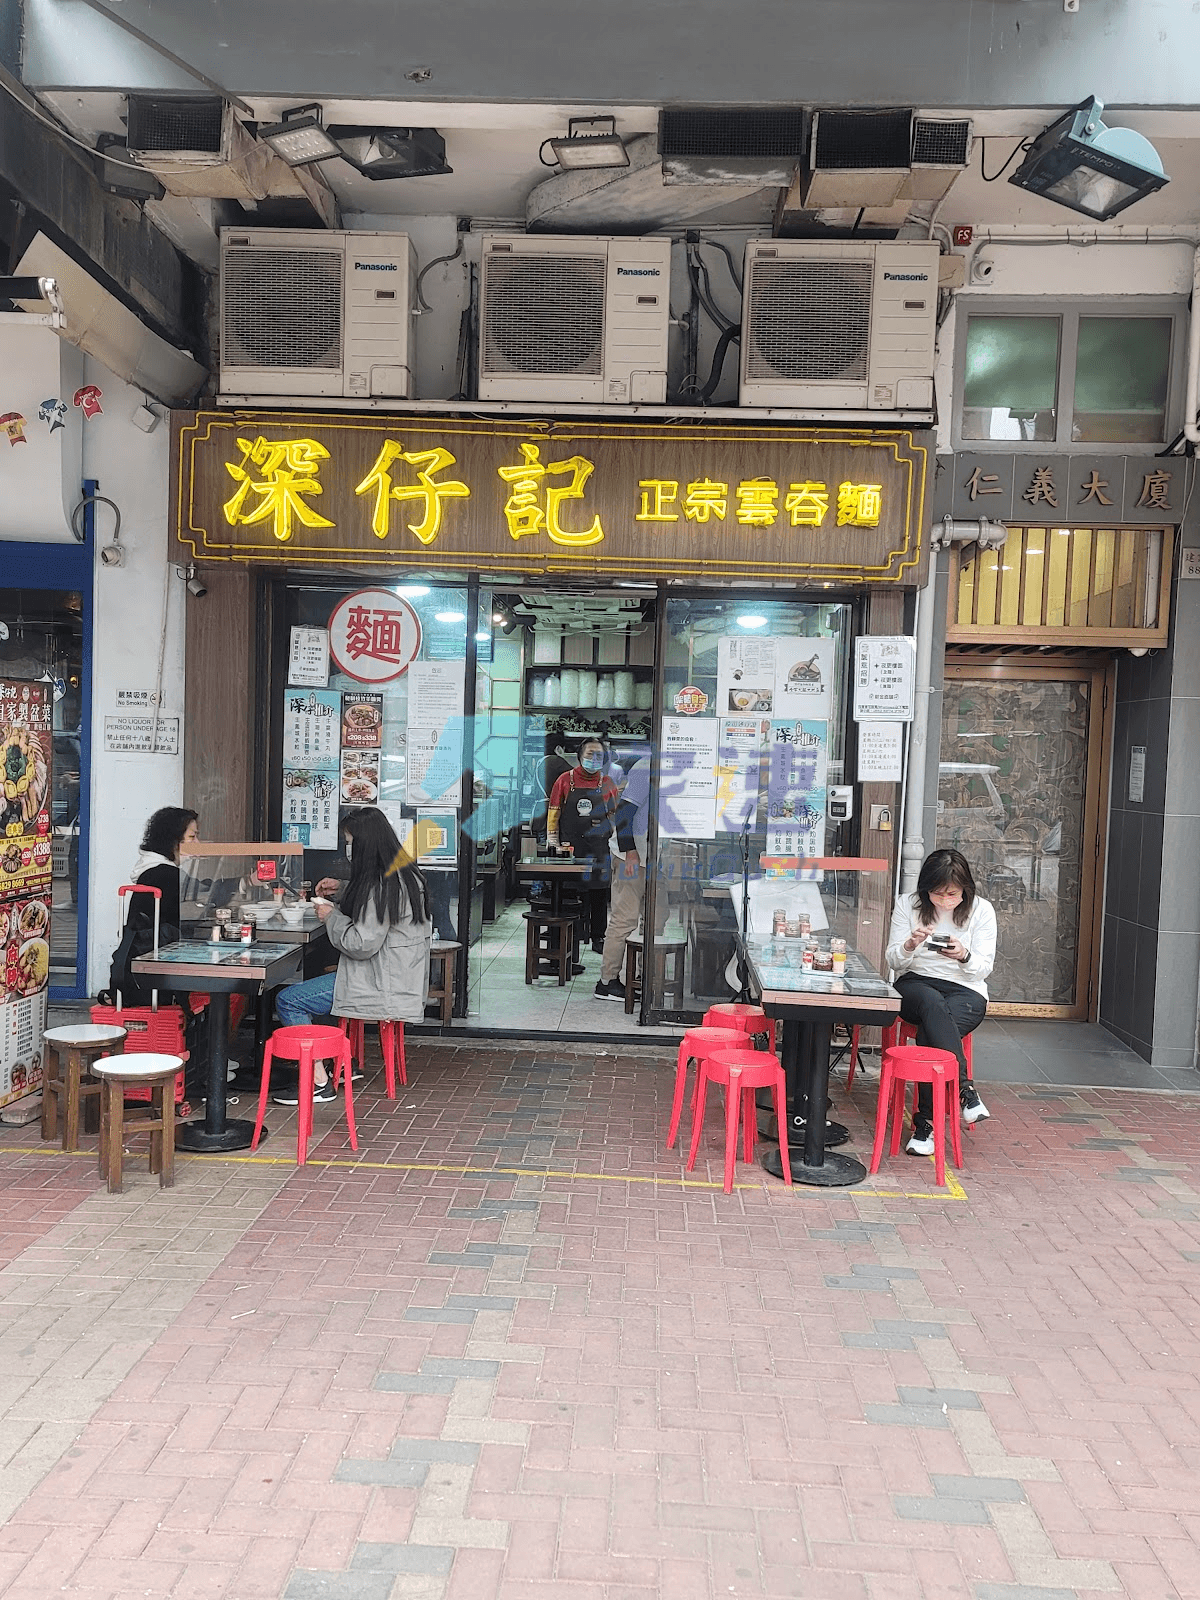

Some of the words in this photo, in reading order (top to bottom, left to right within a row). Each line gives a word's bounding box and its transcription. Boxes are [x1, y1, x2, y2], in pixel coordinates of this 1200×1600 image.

[958, 229, 970, 241] FS
[354, 262, 398, 271] Panasonic
[617, 267, 661, 276] Panasonic
[883, 272, 929, 281] Panasonic
[222, 436, 605, 547] 深仔記
[964, 465, 1173, 510] 仁義大廈
[636, 476, 882, 528] 正宗雲吞麵
[346, 605, 403, 665] 麵
[107, 734, 176, 743] 禁止任何十八歲下人士
